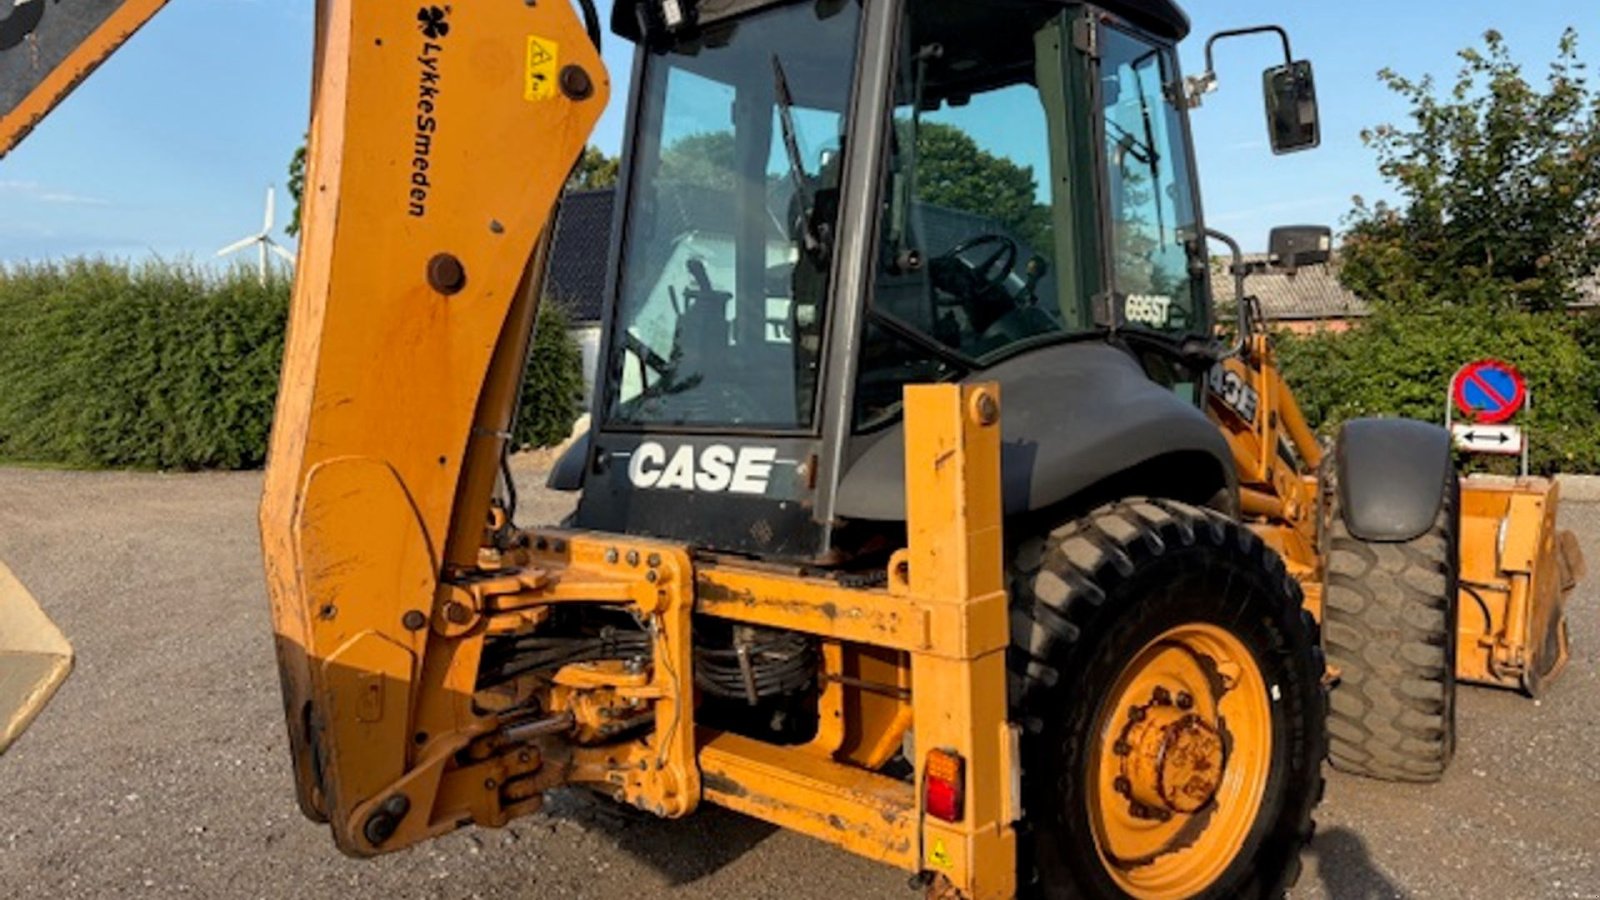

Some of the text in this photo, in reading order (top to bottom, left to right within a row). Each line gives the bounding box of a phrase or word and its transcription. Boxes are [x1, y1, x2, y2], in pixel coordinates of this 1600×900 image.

[408, 42, 443, 217] LykkeSmeden
[1210, 362, 1257, 421] ASE
[628, 441, 778, 494] CASE
